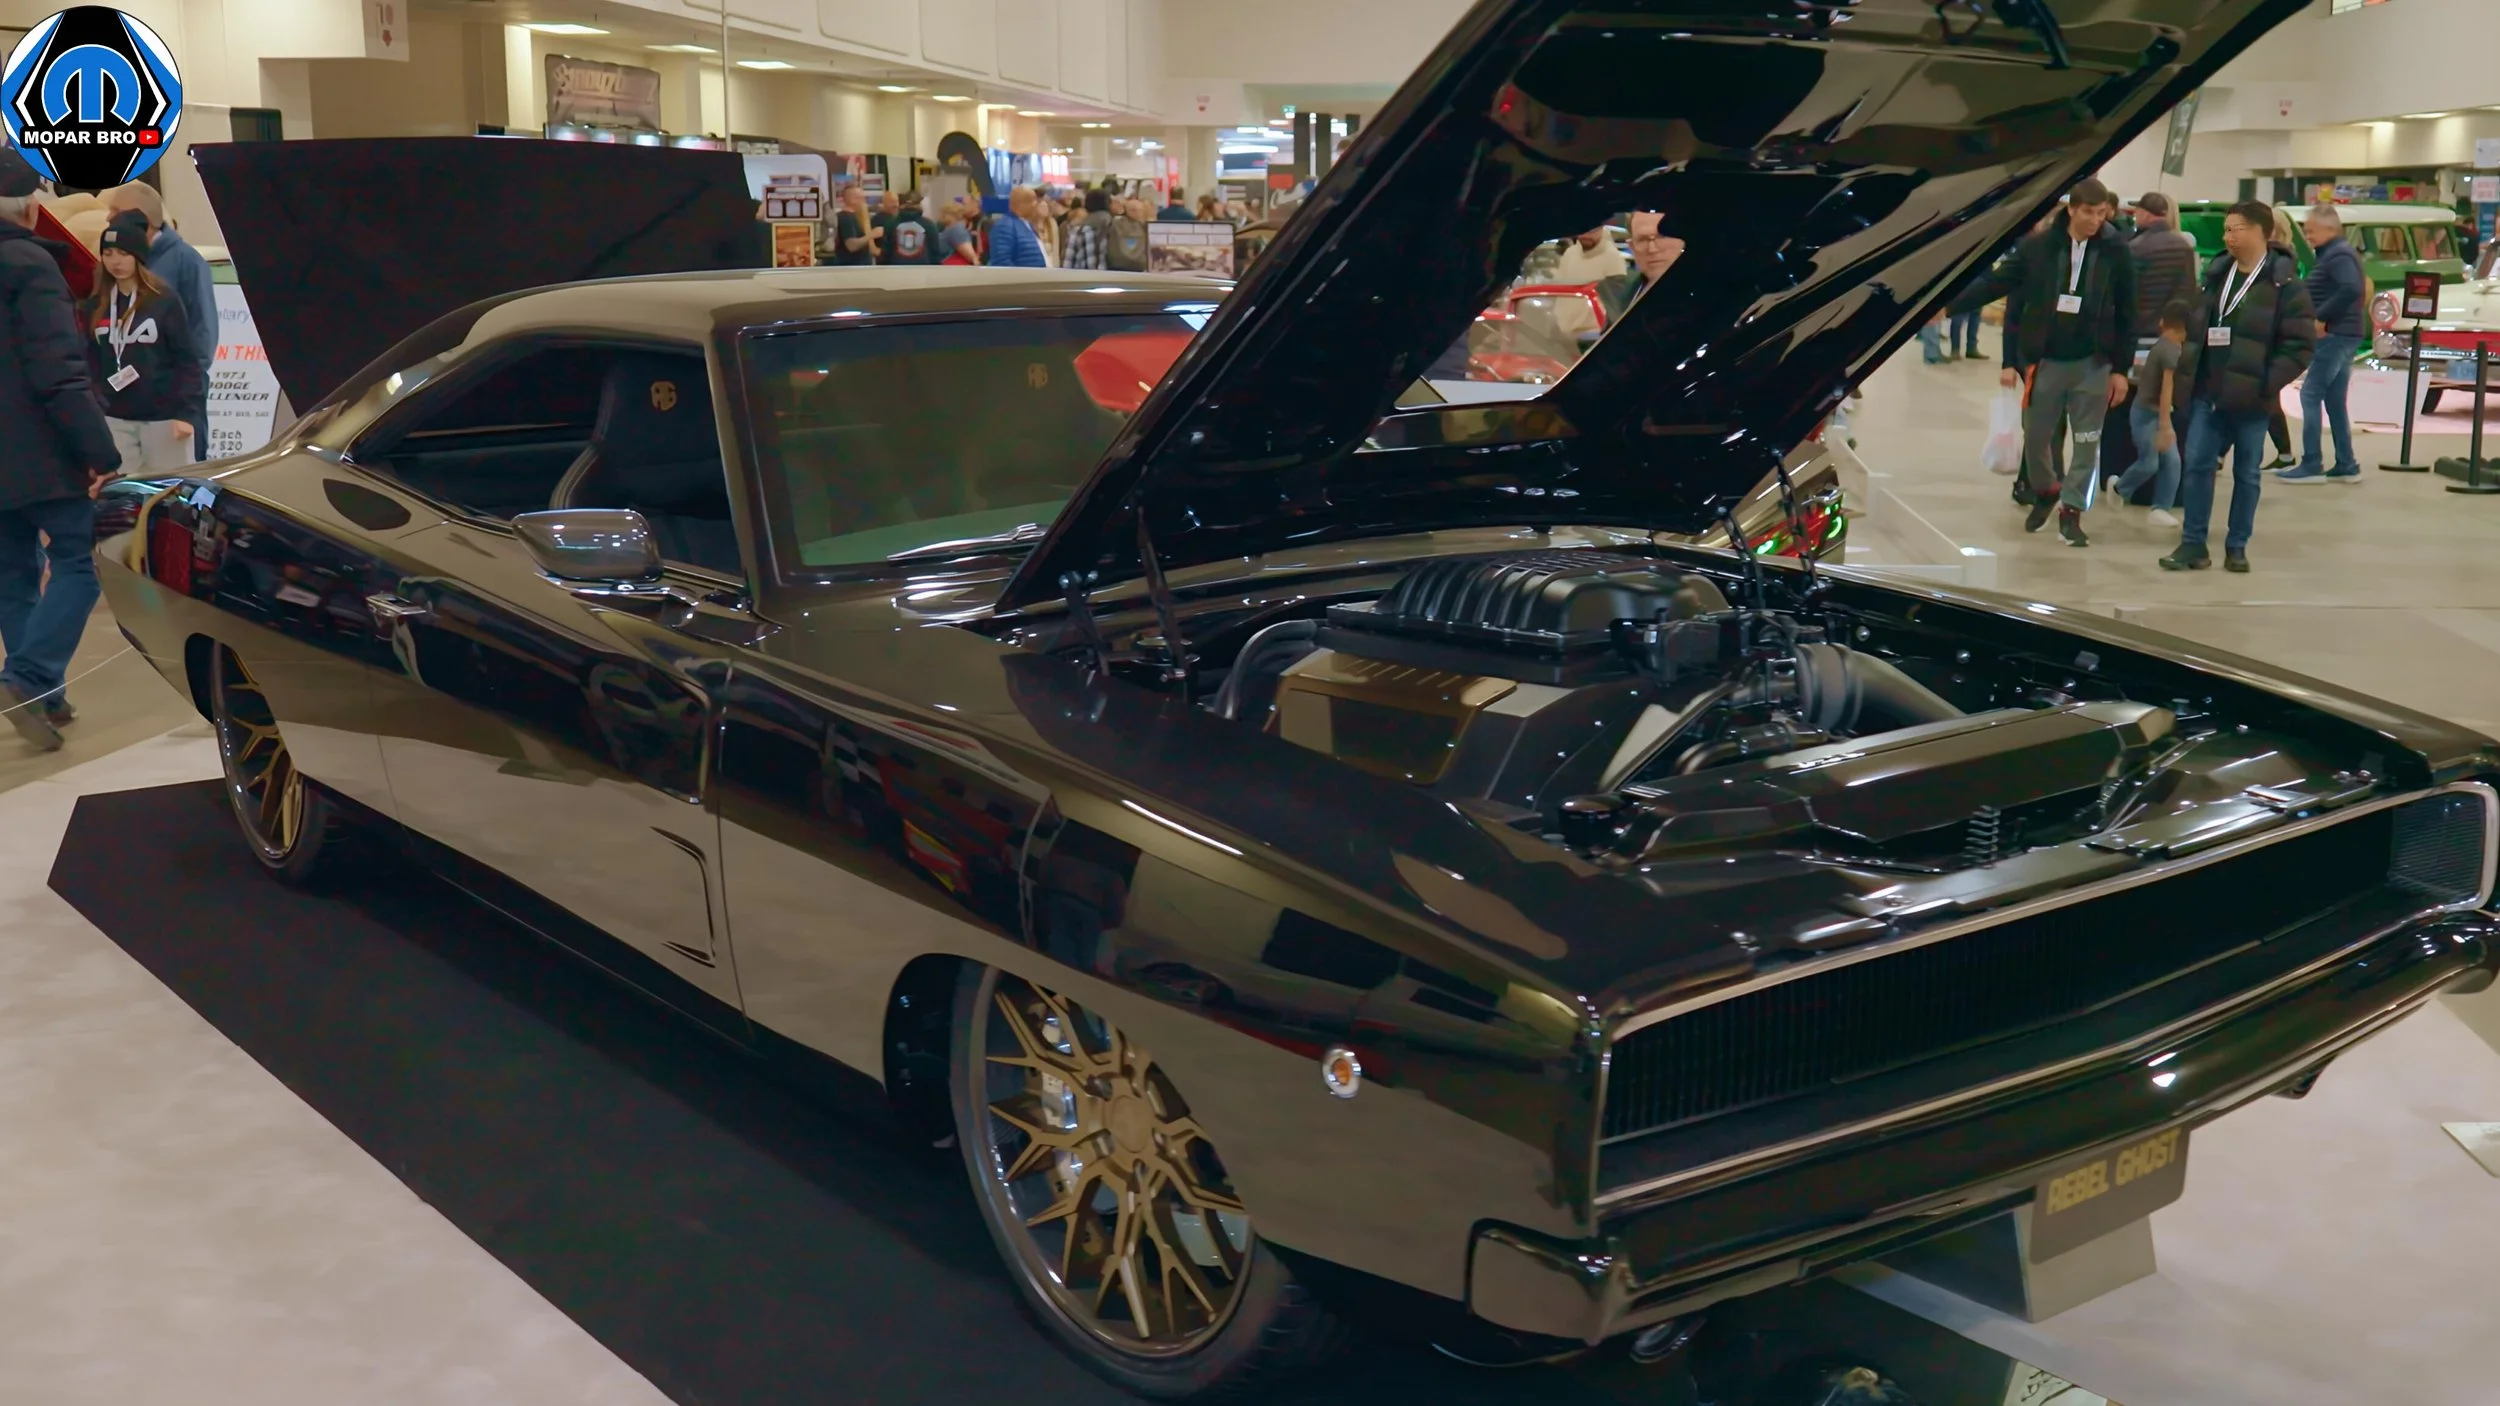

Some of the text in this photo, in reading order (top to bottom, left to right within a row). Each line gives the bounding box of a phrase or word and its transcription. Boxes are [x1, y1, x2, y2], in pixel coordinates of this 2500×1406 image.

[212, 428, 242, 439] Each
[2046, 1127, 2182, 1215] REBEL GHOST
